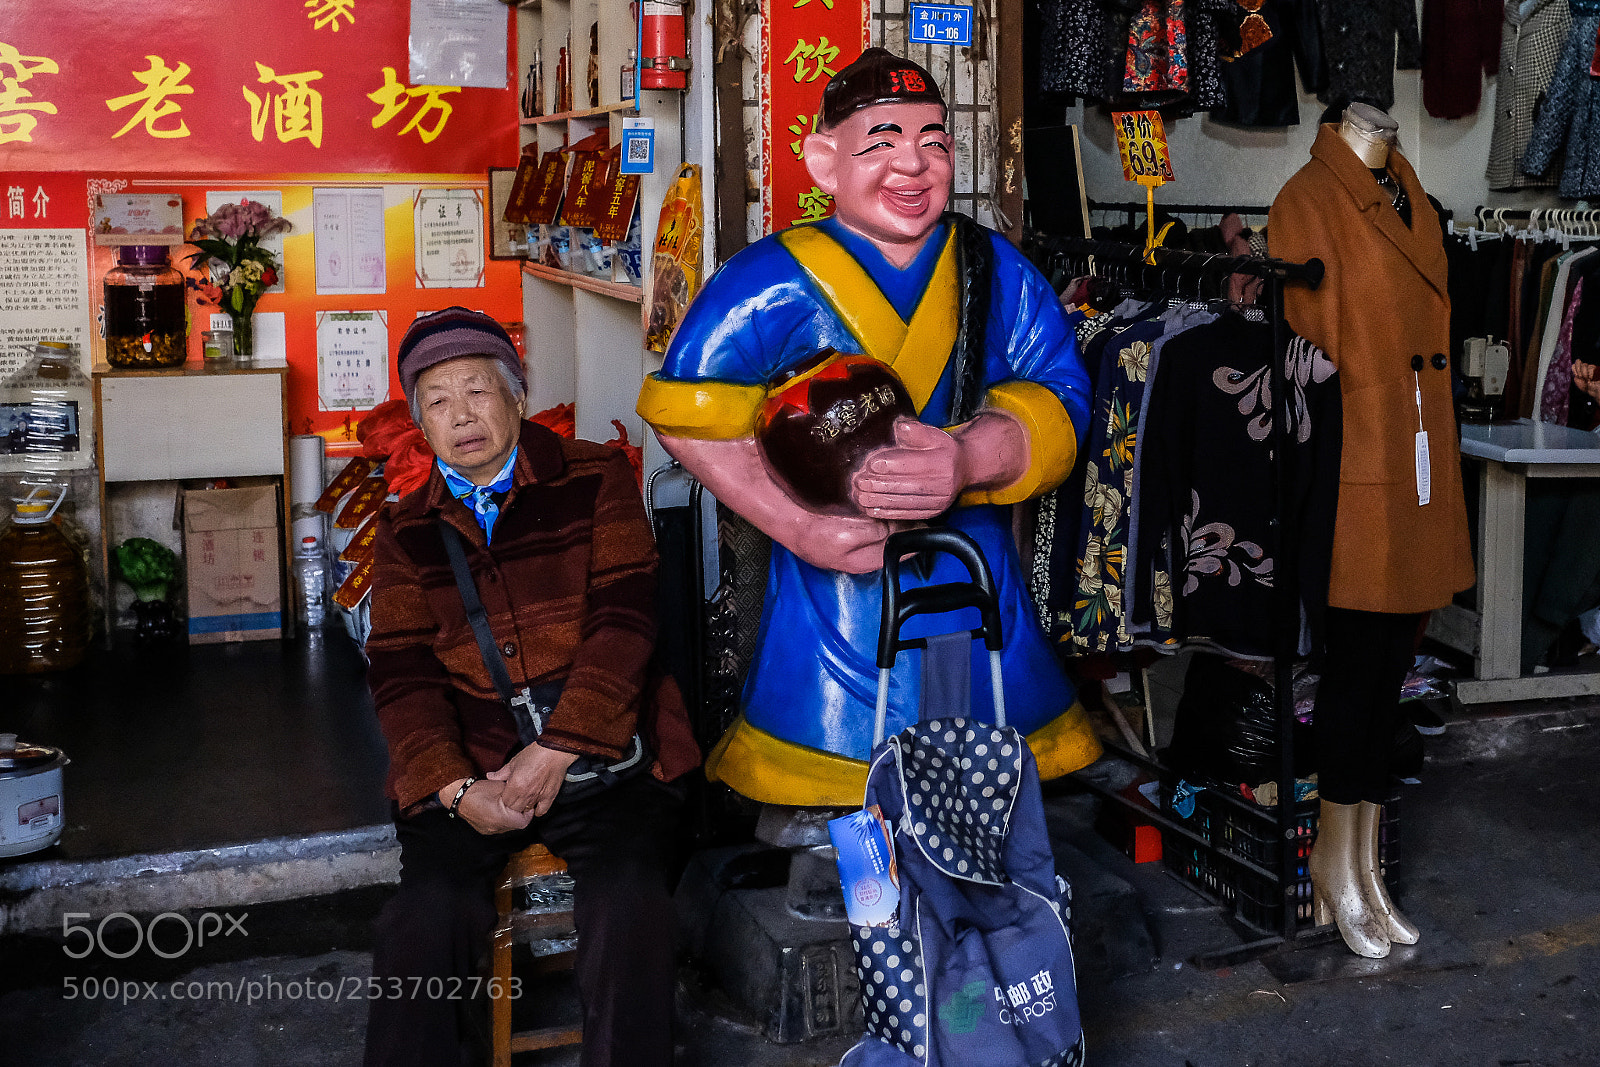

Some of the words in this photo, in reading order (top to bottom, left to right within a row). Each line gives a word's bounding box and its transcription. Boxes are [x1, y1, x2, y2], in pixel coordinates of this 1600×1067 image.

[919, 9, 963, 22] 金川门外
[889, 68, 927, 93] 酒
[1120, 112, 1153, 140] 特价
[7, 185, 50, 219] 简介
[1022, 991, 1058, 1023] POST
